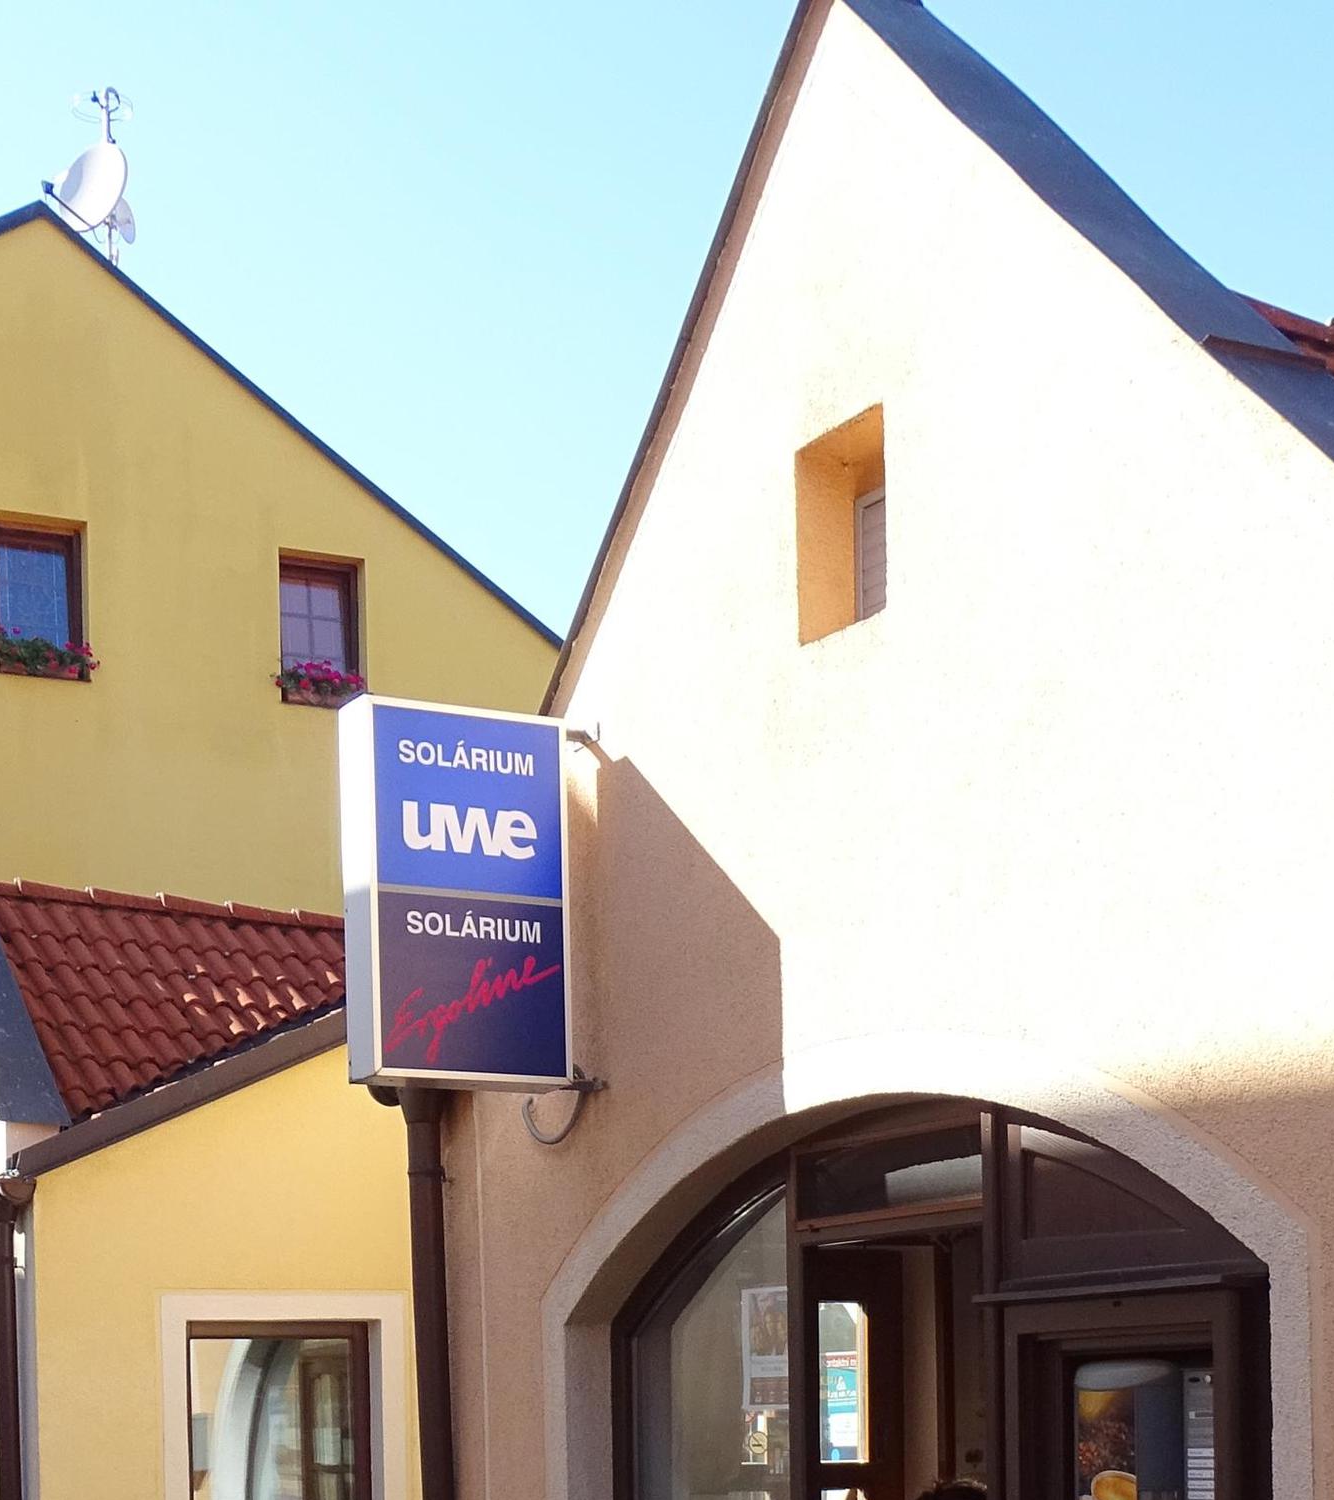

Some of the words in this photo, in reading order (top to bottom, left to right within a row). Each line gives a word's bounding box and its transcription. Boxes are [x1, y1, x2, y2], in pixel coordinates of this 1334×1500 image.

[398, 738, 534, 777] SOLÁRIUM
[402, 800, 537, 860] uwe
[406, 910, 541, 944] SOLÁRIUM
